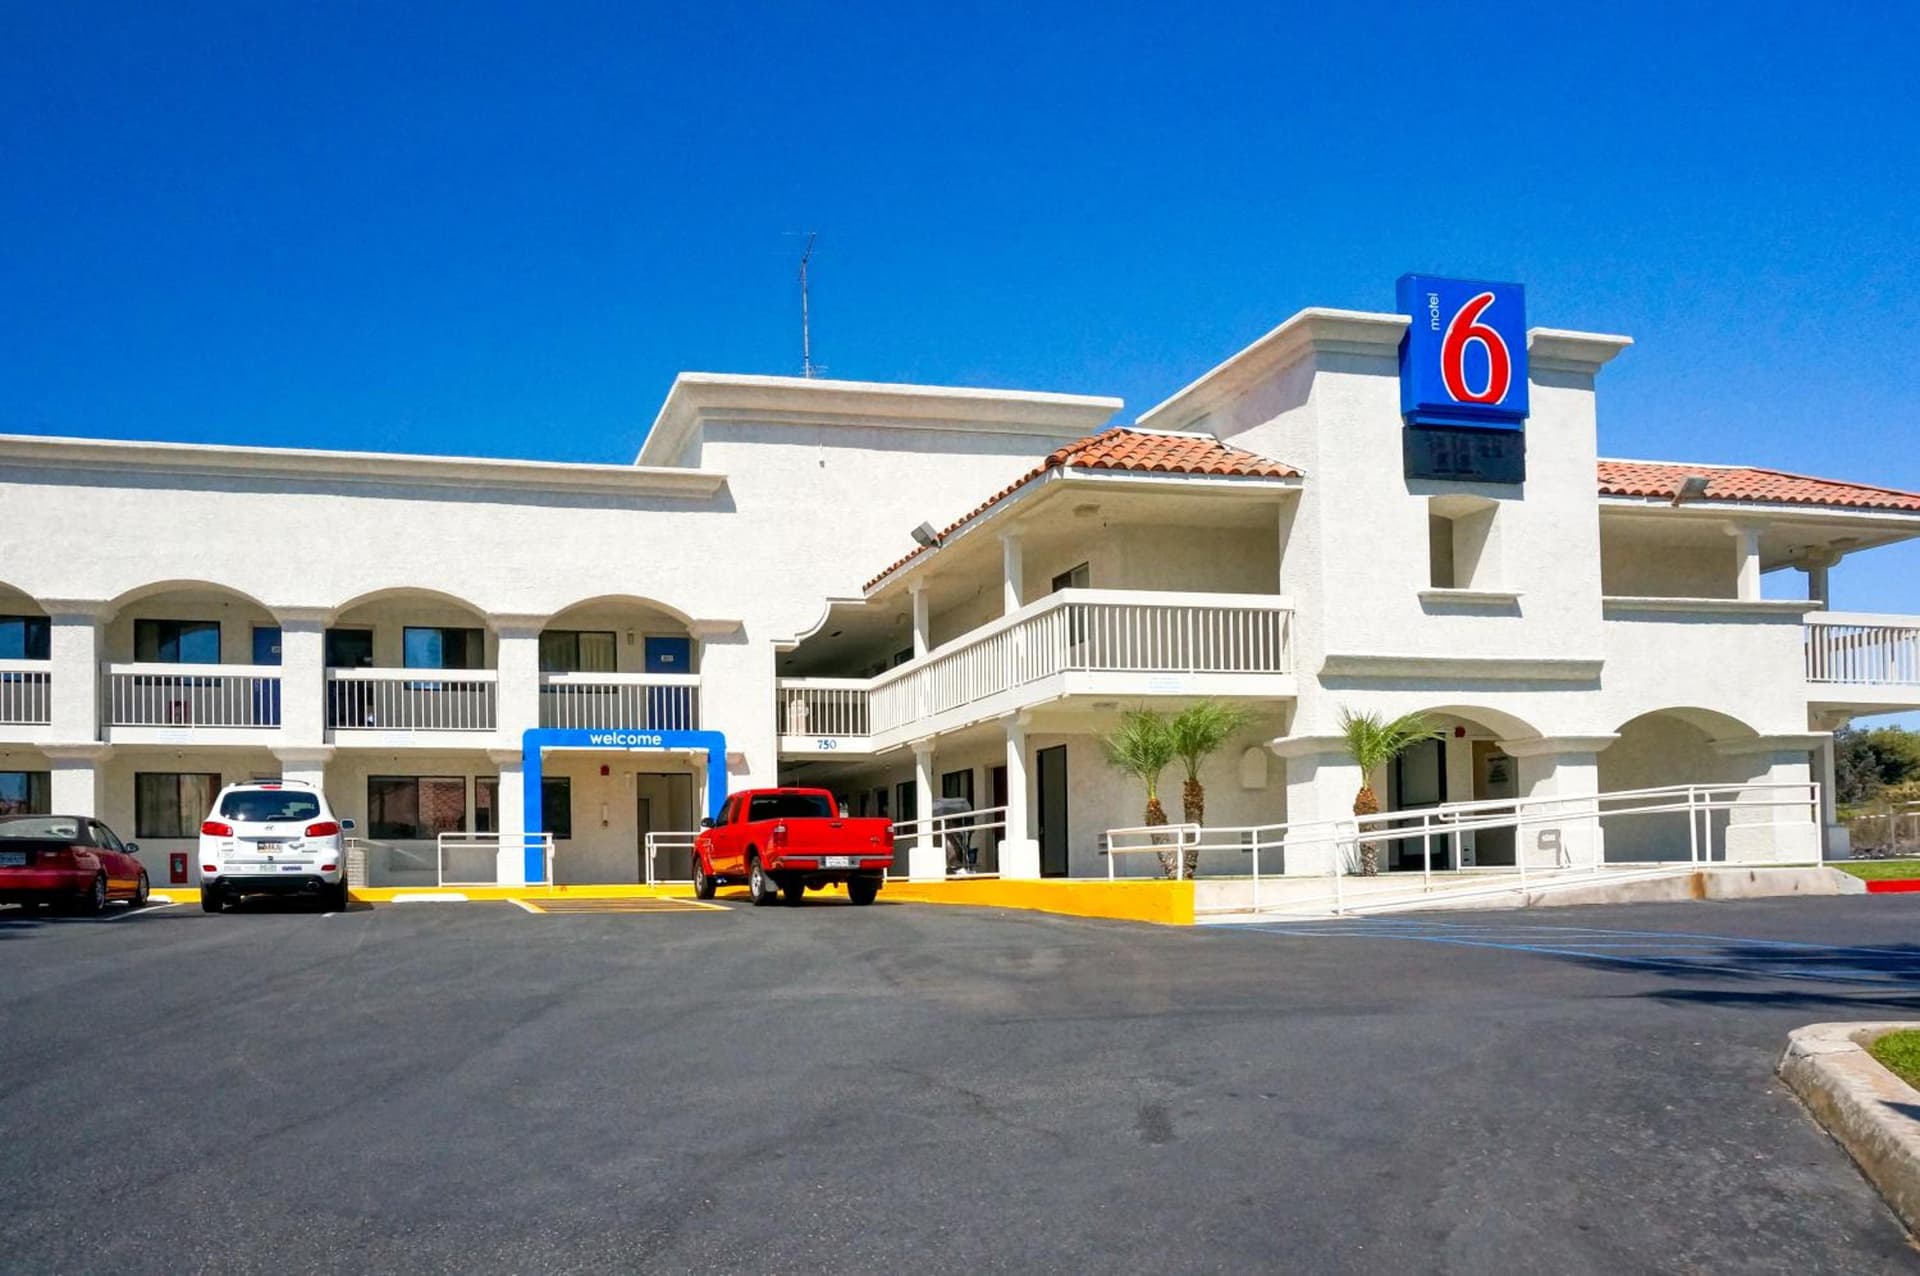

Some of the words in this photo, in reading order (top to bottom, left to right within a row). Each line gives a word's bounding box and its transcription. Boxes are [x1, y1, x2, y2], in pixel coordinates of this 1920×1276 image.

[1426, 292, 1440, 330] motel
[1441, 291, 1511, 405] 6
[589, 731, 662, 745] welcome
[817, 739, 837, 750] 750
